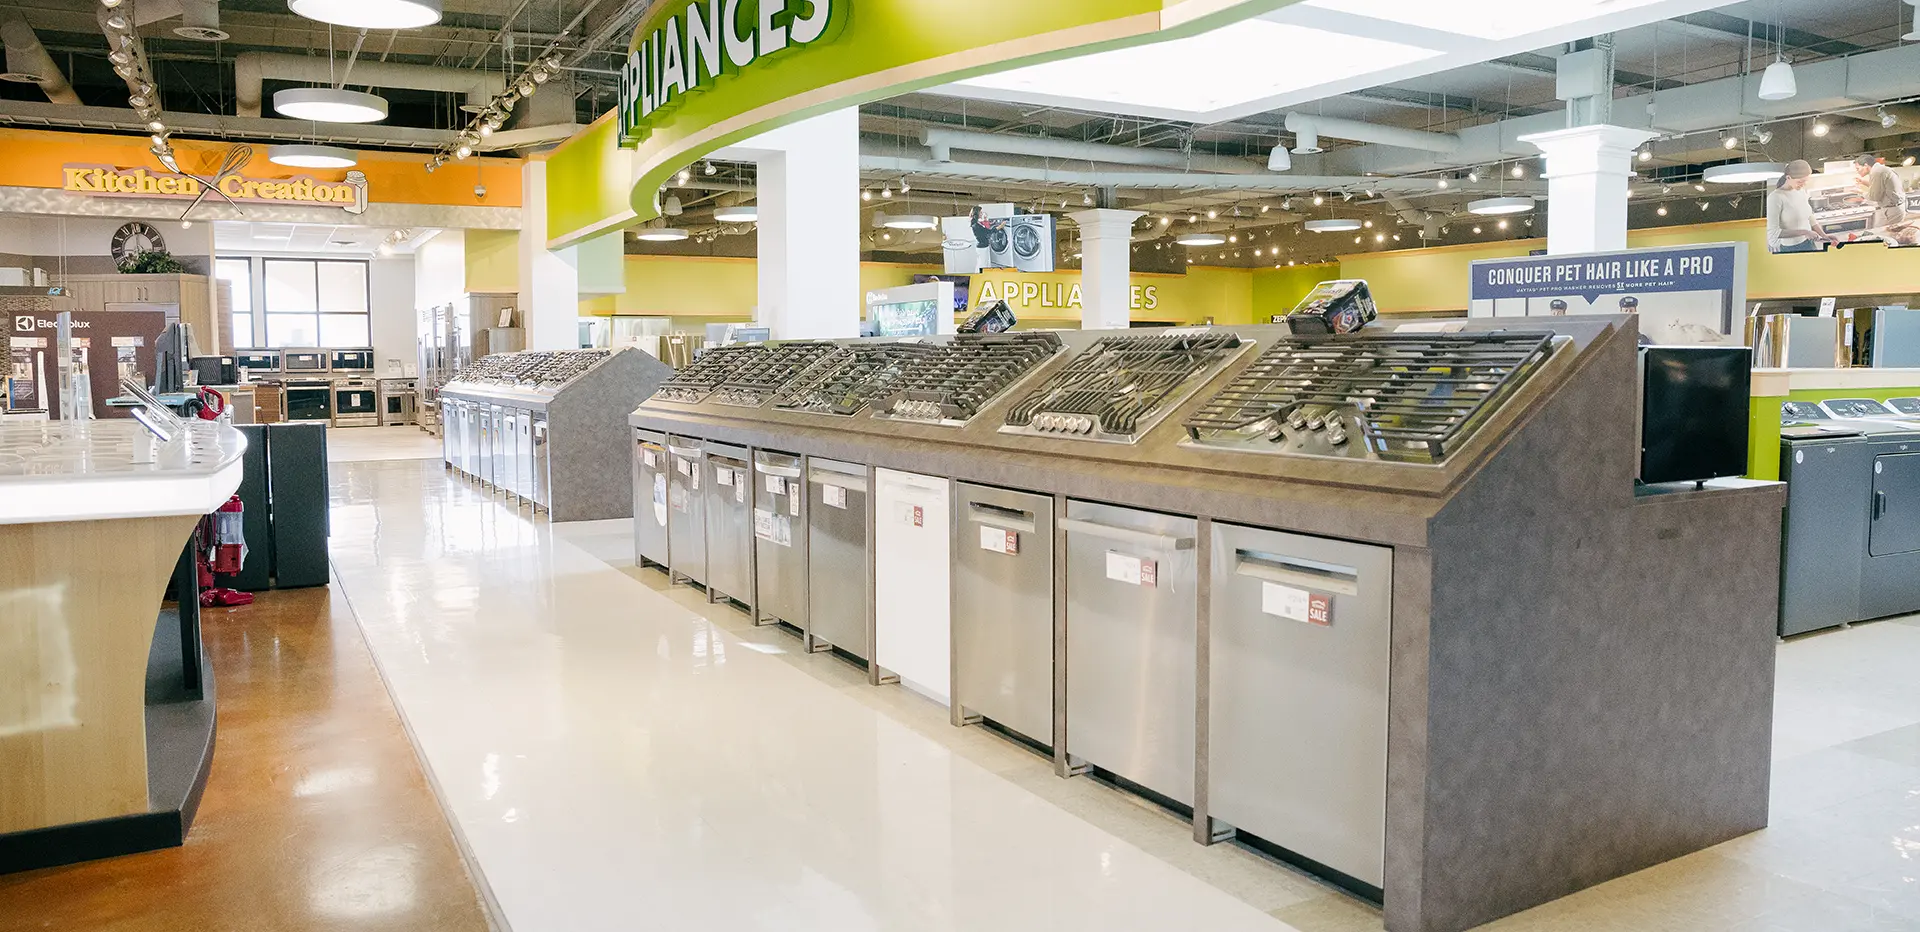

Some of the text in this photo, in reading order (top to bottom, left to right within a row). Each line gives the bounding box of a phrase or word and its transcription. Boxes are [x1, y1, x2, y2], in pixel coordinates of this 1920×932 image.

[617, 0, 830, 149] APPLIANCES
[62, 167, 354, 204] Kitchen Creation
[1488, 255, 1713, 286] CONQUER PET HAIR LIKE A PRO
[978, 281, 1158, 309] APPLIAES
[37, 319, 91, 329] Elecolux
[1141, 572, 1154, 584] SALE
[1309, 608, 1328, 623] SALE
